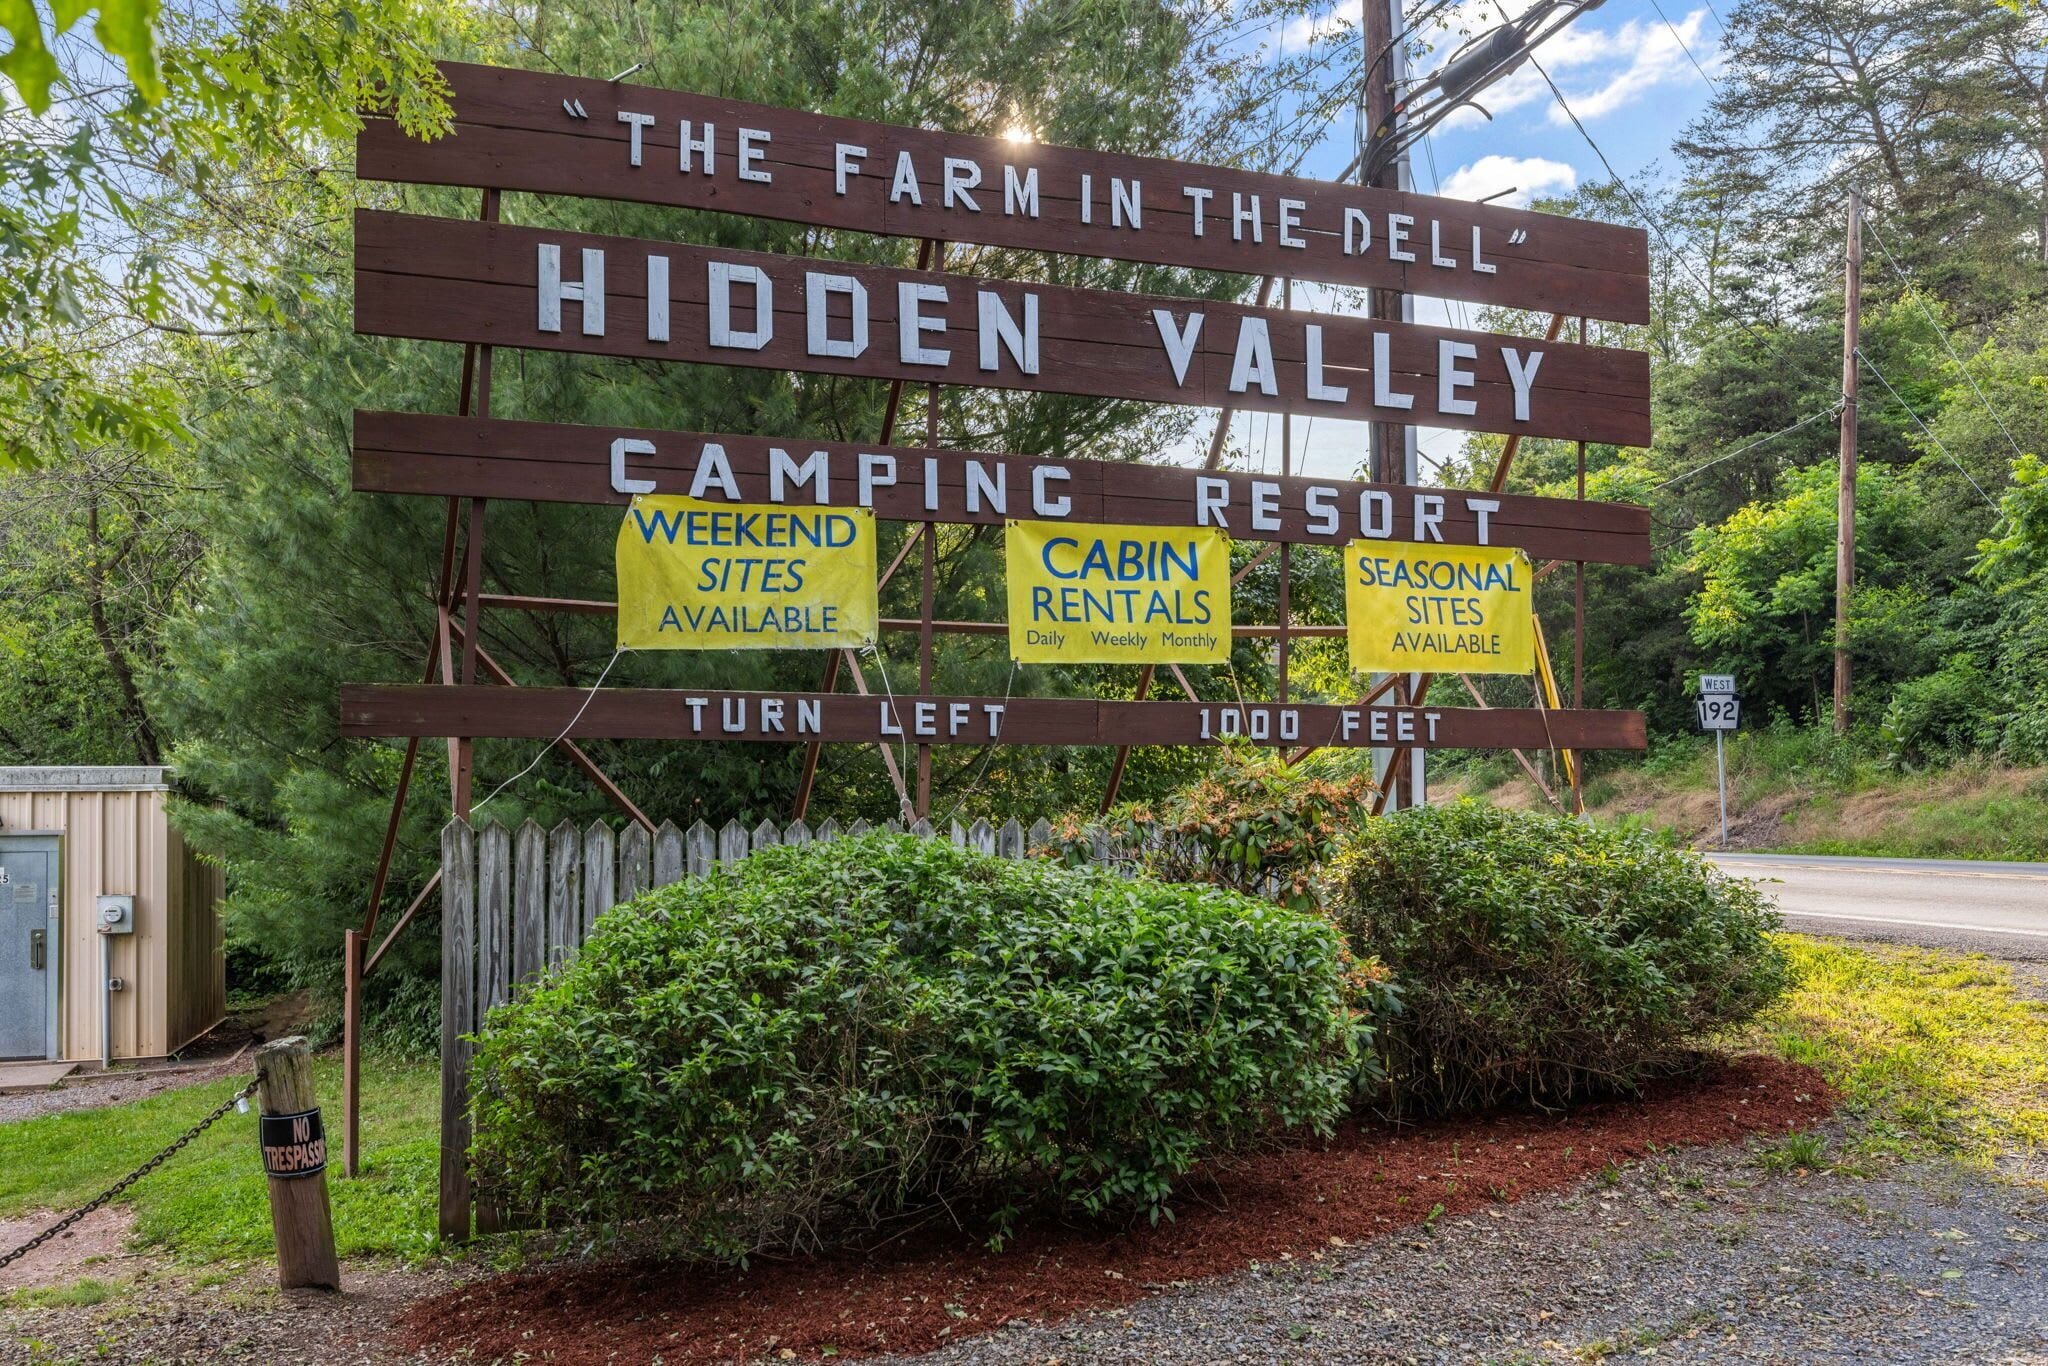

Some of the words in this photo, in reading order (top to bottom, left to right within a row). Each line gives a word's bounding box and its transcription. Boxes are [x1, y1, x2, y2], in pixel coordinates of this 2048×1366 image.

[836, 143, 1039, 218] FARM
[1081, 174, 1141, 229] IN
[1183, 186, 1306, 248] THE
[538, 243, 1040, 375] HIDDEN
[1153, 310, 1544, 421] VALLEY
[610, 438, 1071, 516] CAMPING
[1196, 476, 1499, 545] RESORT
[633, 509, 857, 548] WEEKEND
[697, 557, 807, 593] SITES
[1042, 538, 1199, 582] CABIN
[1359, 556, 1520, 592] SEASONAL
[658, 605, 839, 633] AVAILABLE
[1033, 587, 1211, 625] RENTALS
[1406, 596, 1484, 626] SITES
[1027, 630, 1065, 649] Daily
[1091, 631, 1148, 650] Weekly
[1162, 632, 1217, 651] Monthly
[1391, 632, 1501, 654] AVAILABLE
[1704, 678, 1731, 690] WEST
[685, 698, 821, 734] TURN
[881, 701, 1004, 737] LEFT
[1200, 709, 1299, 740] 1000
[1342, 711, 1441, 742] FEET
[1702, 702, 1736, 721] 192
[292, 1116, 310, 1143] NO
